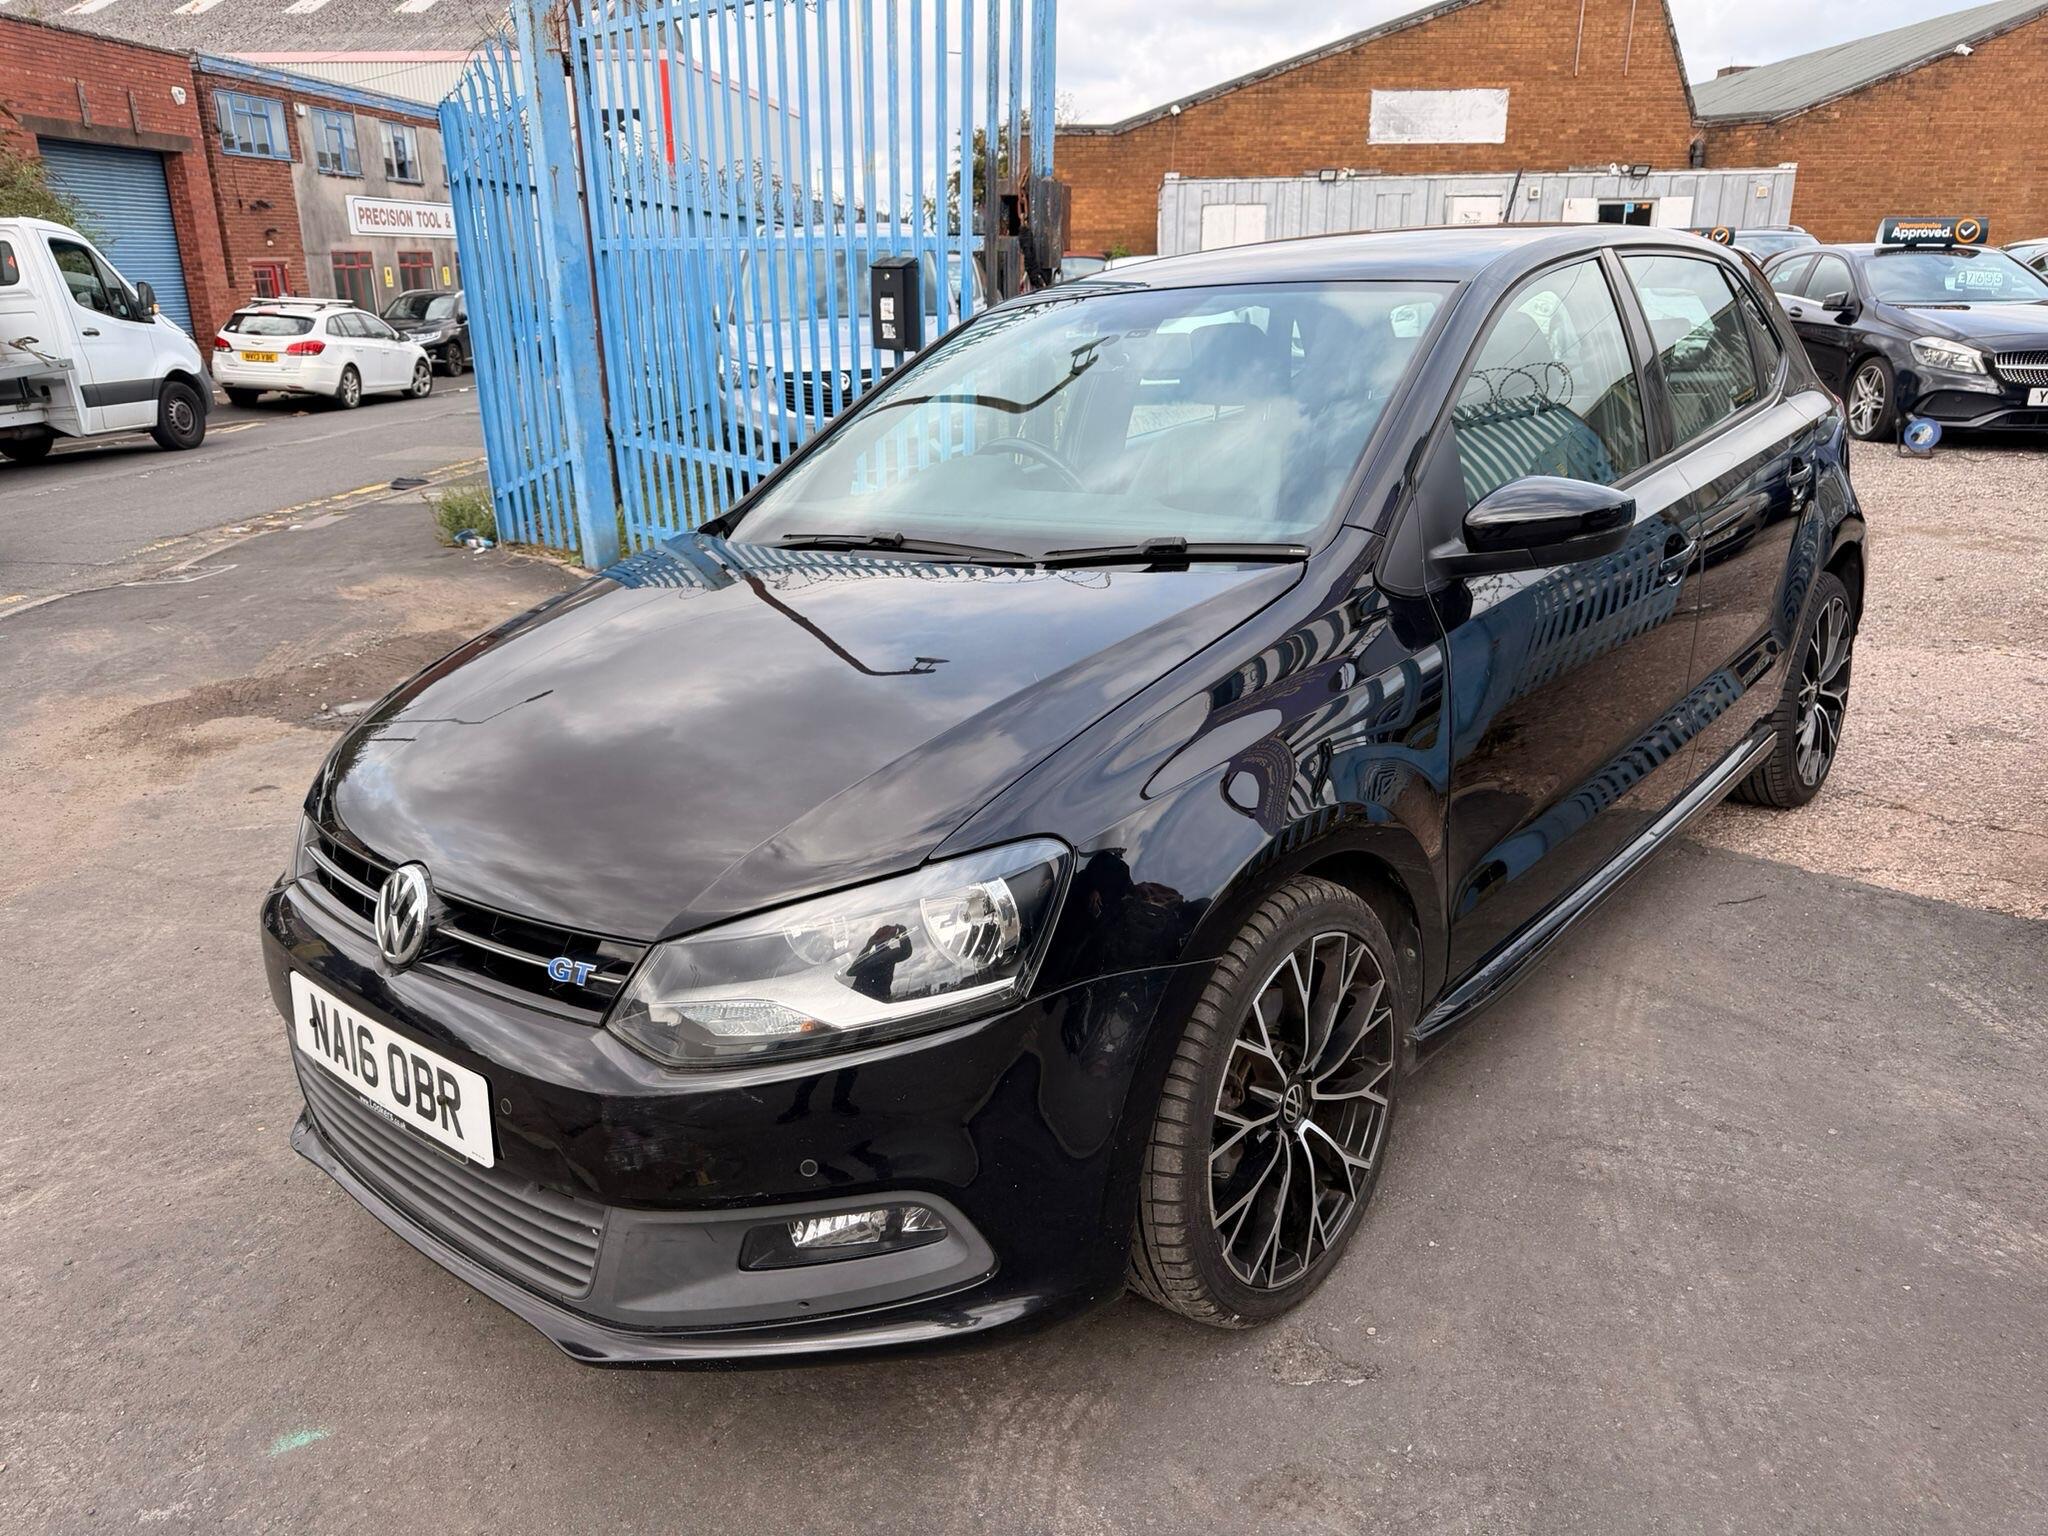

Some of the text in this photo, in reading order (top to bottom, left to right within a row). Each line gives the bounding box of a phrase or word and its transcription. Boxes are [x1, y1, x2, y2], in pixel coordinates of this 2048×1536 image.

[358, 207, 452, 229] PRECISION TOOL &
[1891, 226, 1953, 240] Approved.
[548, 956, 597, 987] GT
[310, 992, 465, 1141] NA16 OBR
